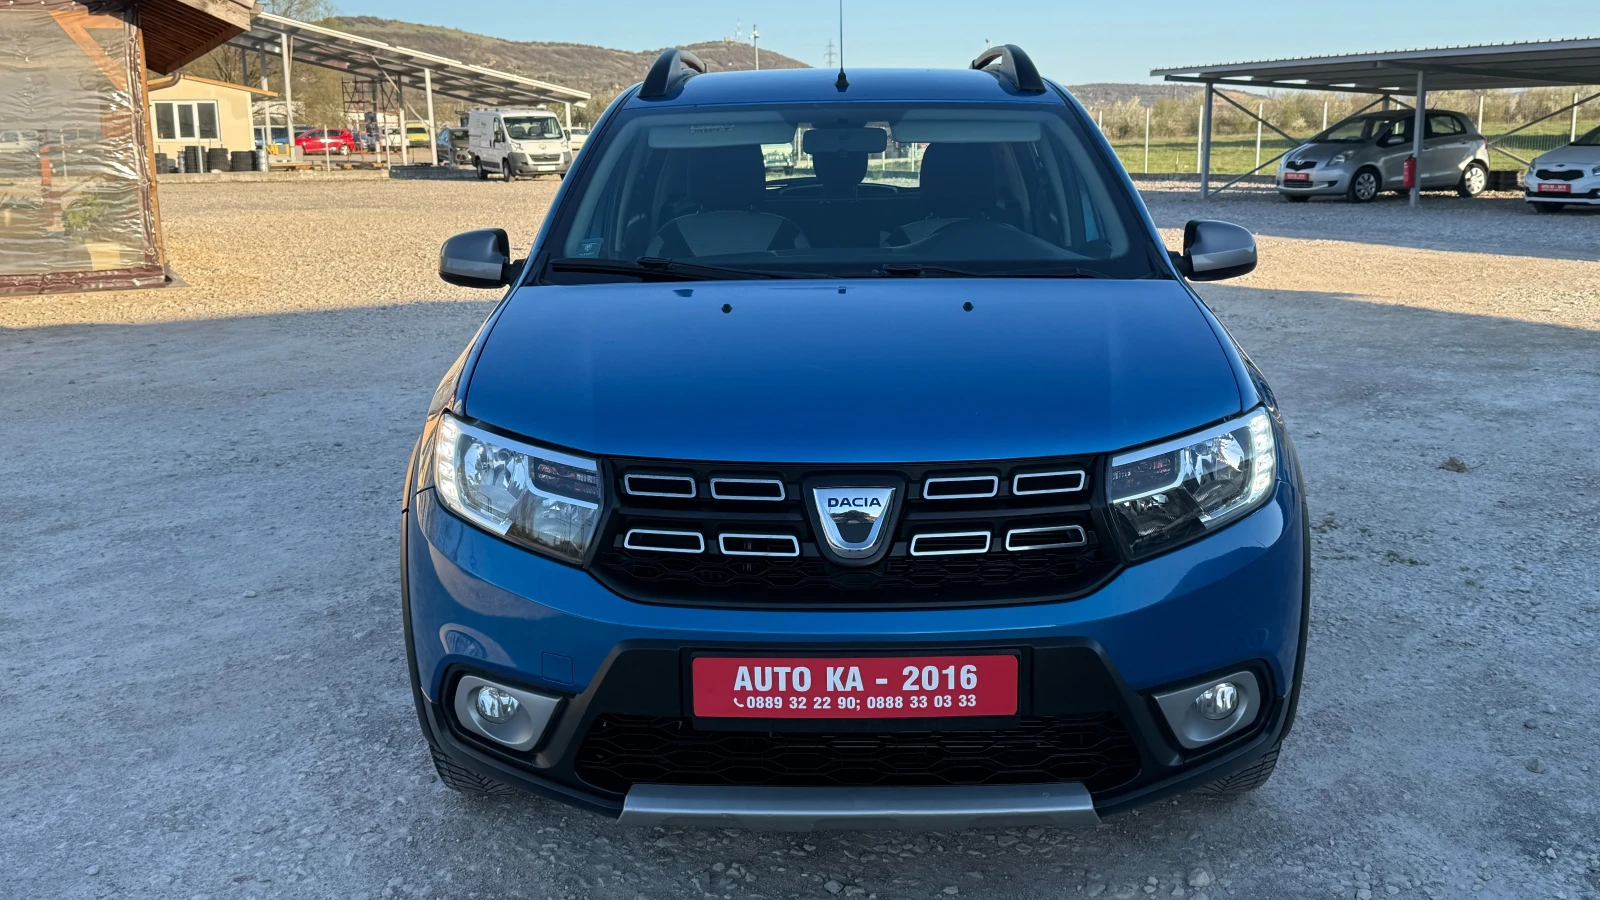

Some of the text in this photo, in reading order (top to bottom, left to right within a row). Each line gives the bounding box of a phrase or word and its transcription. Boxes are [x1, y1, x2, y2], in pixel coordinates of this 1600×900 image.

[827, 497, 881, 508] DACIA
[734, 666, 811, 692] AUTO
[827, 667, 864, 691] KA
[902, 665, 977, 690] 2016
[747, 694, 976, 711] 0889 32 22 90; 0888 33 03 33
